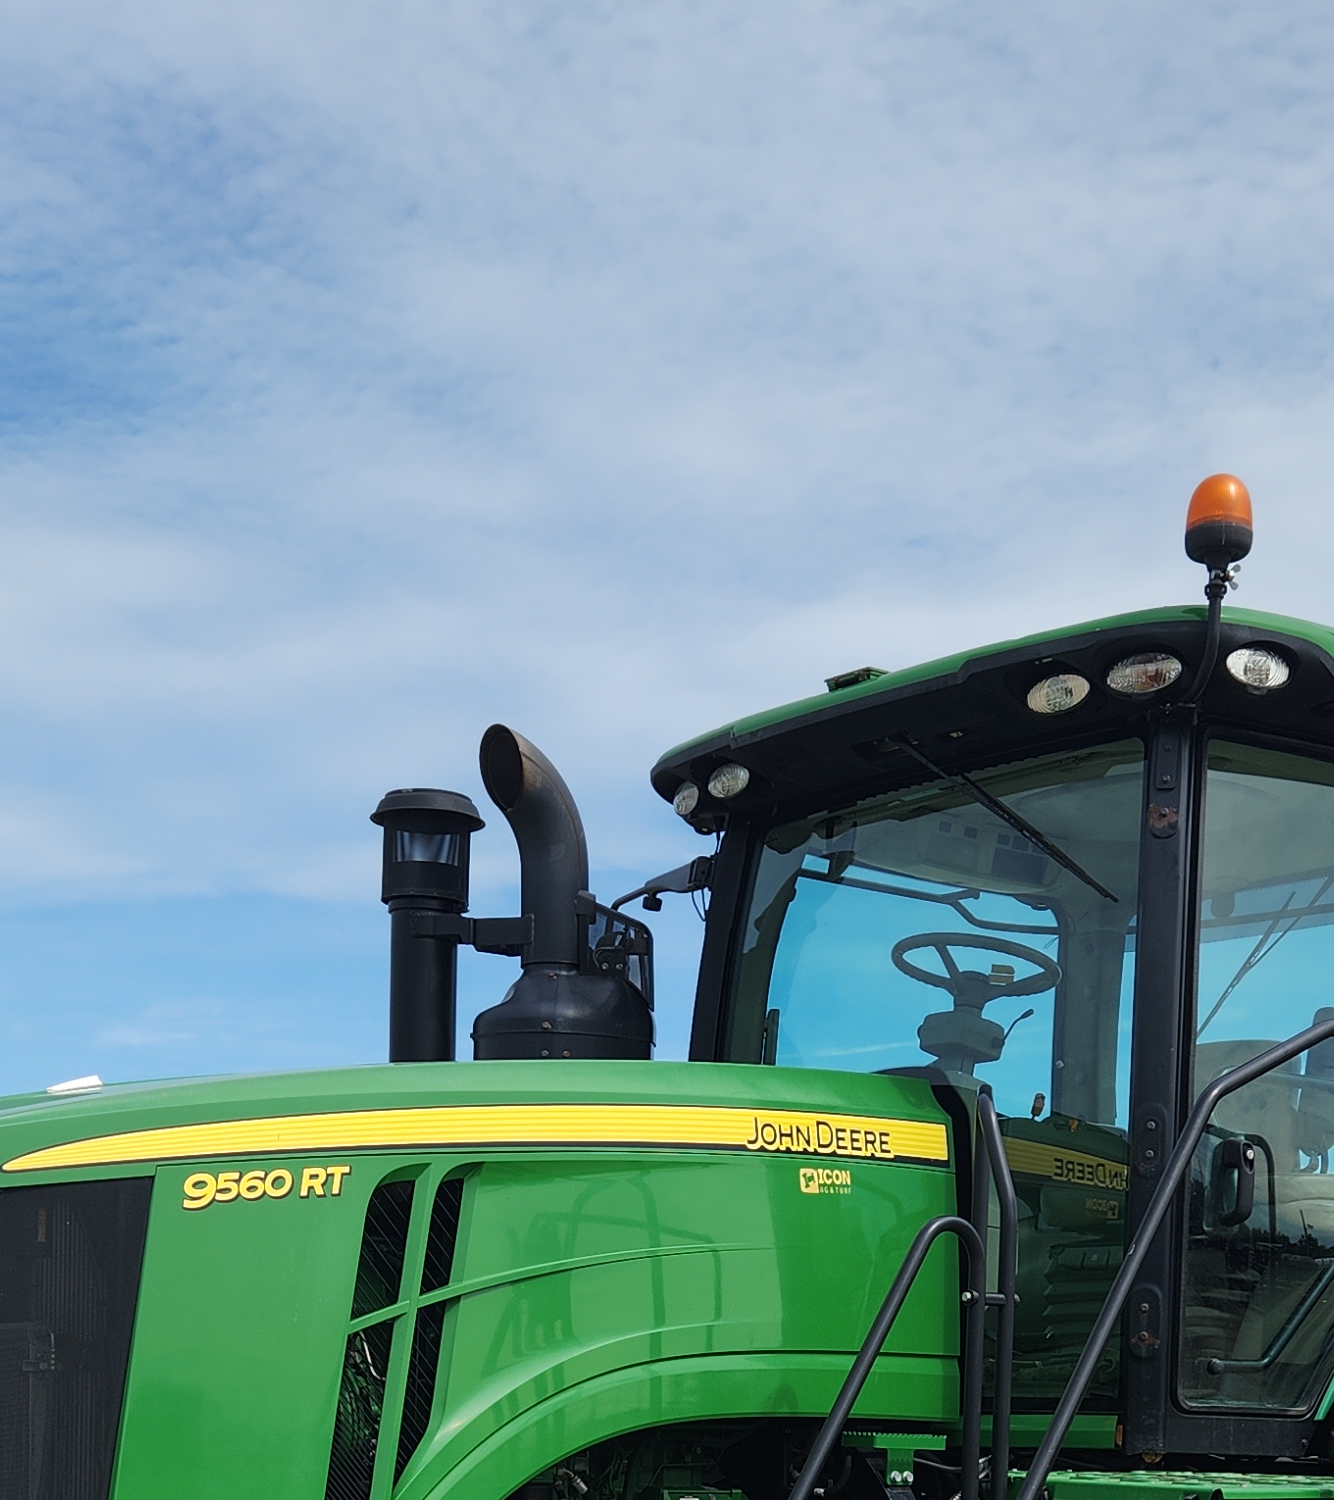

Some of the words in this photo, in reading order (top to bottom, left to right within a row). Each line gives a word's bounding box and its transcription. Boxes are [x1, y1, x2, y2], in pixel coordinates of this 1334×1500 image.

[747, 1117, 812, 1148] JOHN
[816, 1120, 893, 1154] DEERE
[182, 1169, 294, 1211] 9560
[299, 1165, 352, 1198] RT
[817, 1168, 852, 1186] ICON
